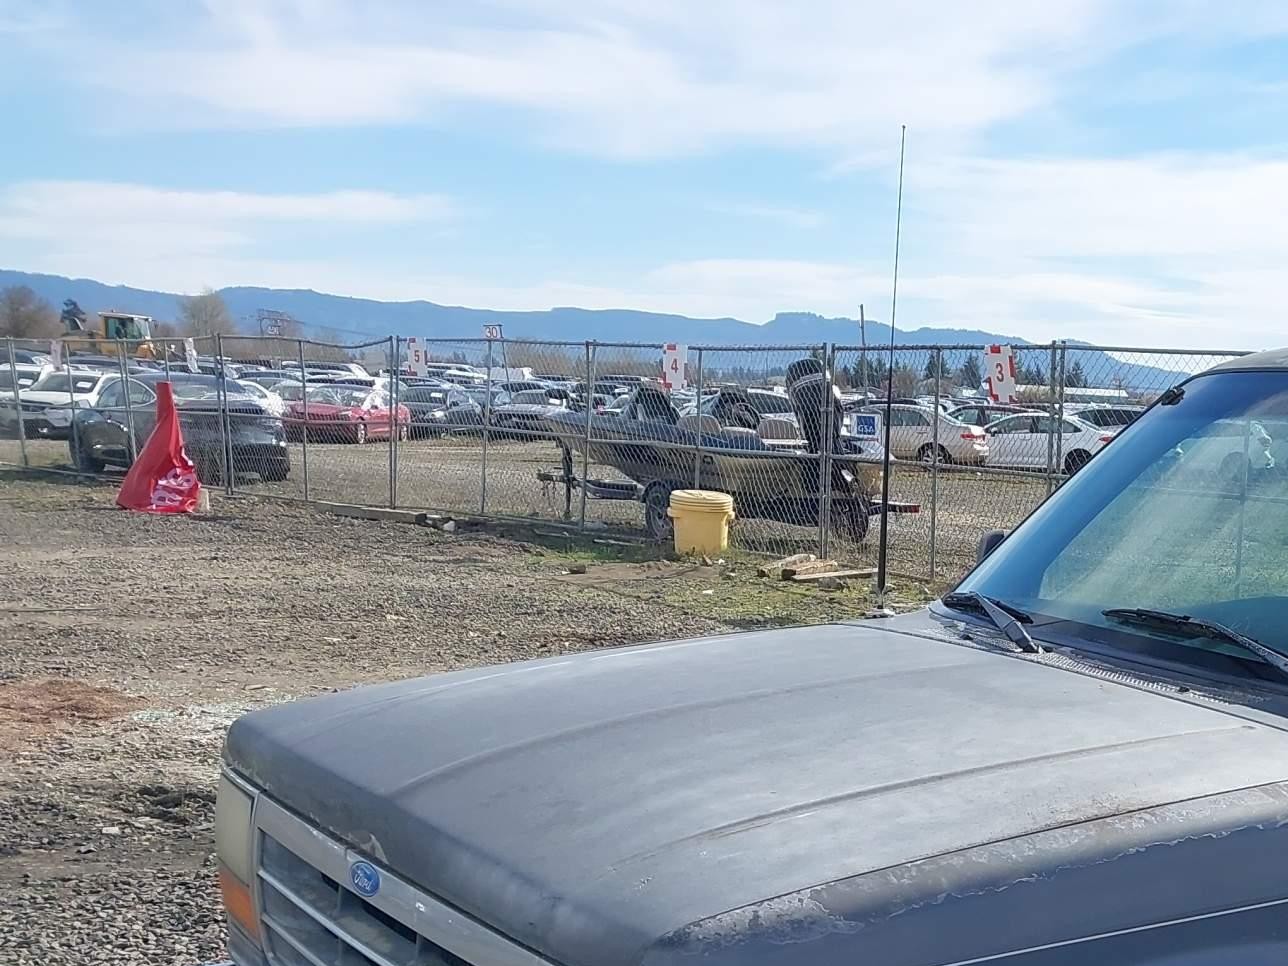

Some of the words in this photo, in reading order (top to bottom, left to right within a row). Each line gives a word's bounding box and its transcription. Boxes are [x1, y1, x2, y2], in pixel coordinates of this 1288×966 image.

[485, 326, 498, 338] 30
[413, 349, 420, 362] 5
[670, 358, 679, 373] 4
[995, 363, 1004, 382] 3
